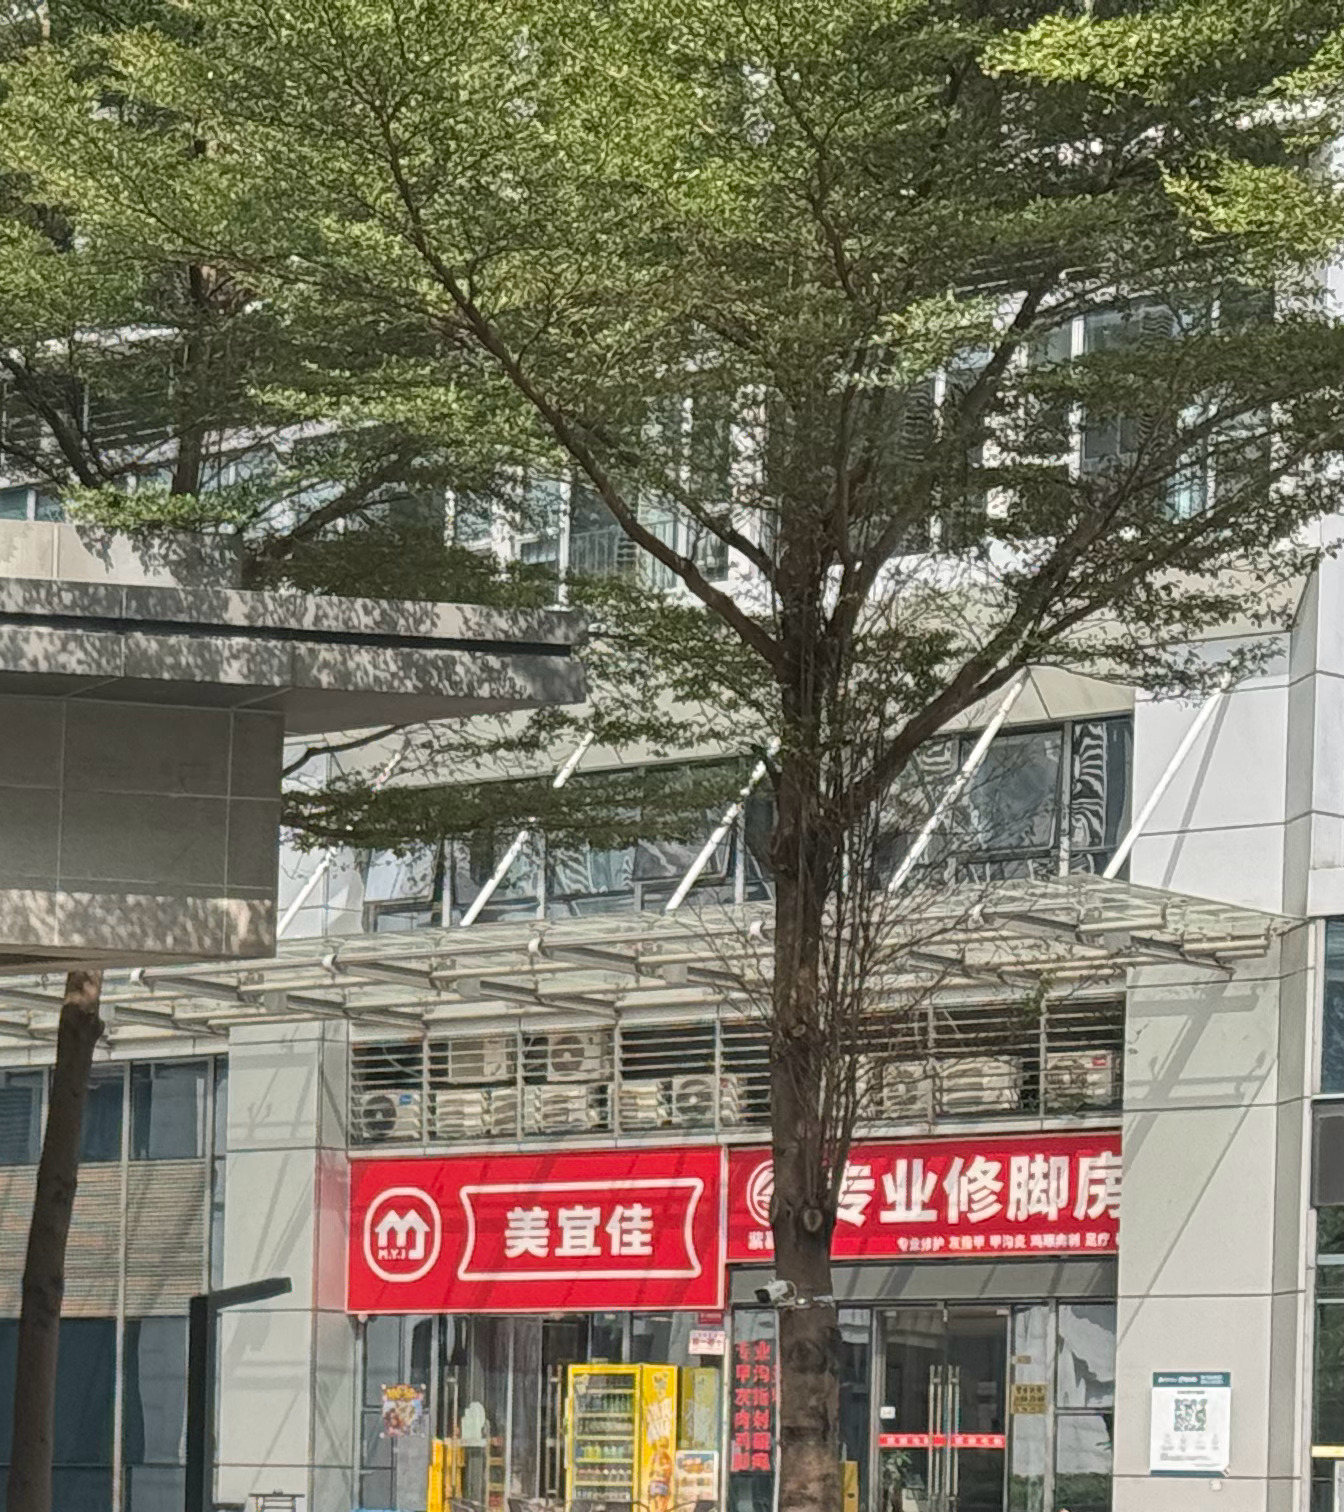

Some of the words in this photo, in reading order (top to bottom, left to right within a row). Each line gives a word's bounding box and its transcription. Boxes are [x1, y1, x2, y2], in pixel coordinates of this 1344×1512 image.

[830, 1151, 1124, 1229] 专业修脚房
[503, 1203, 654, 1258] 美宜佳
